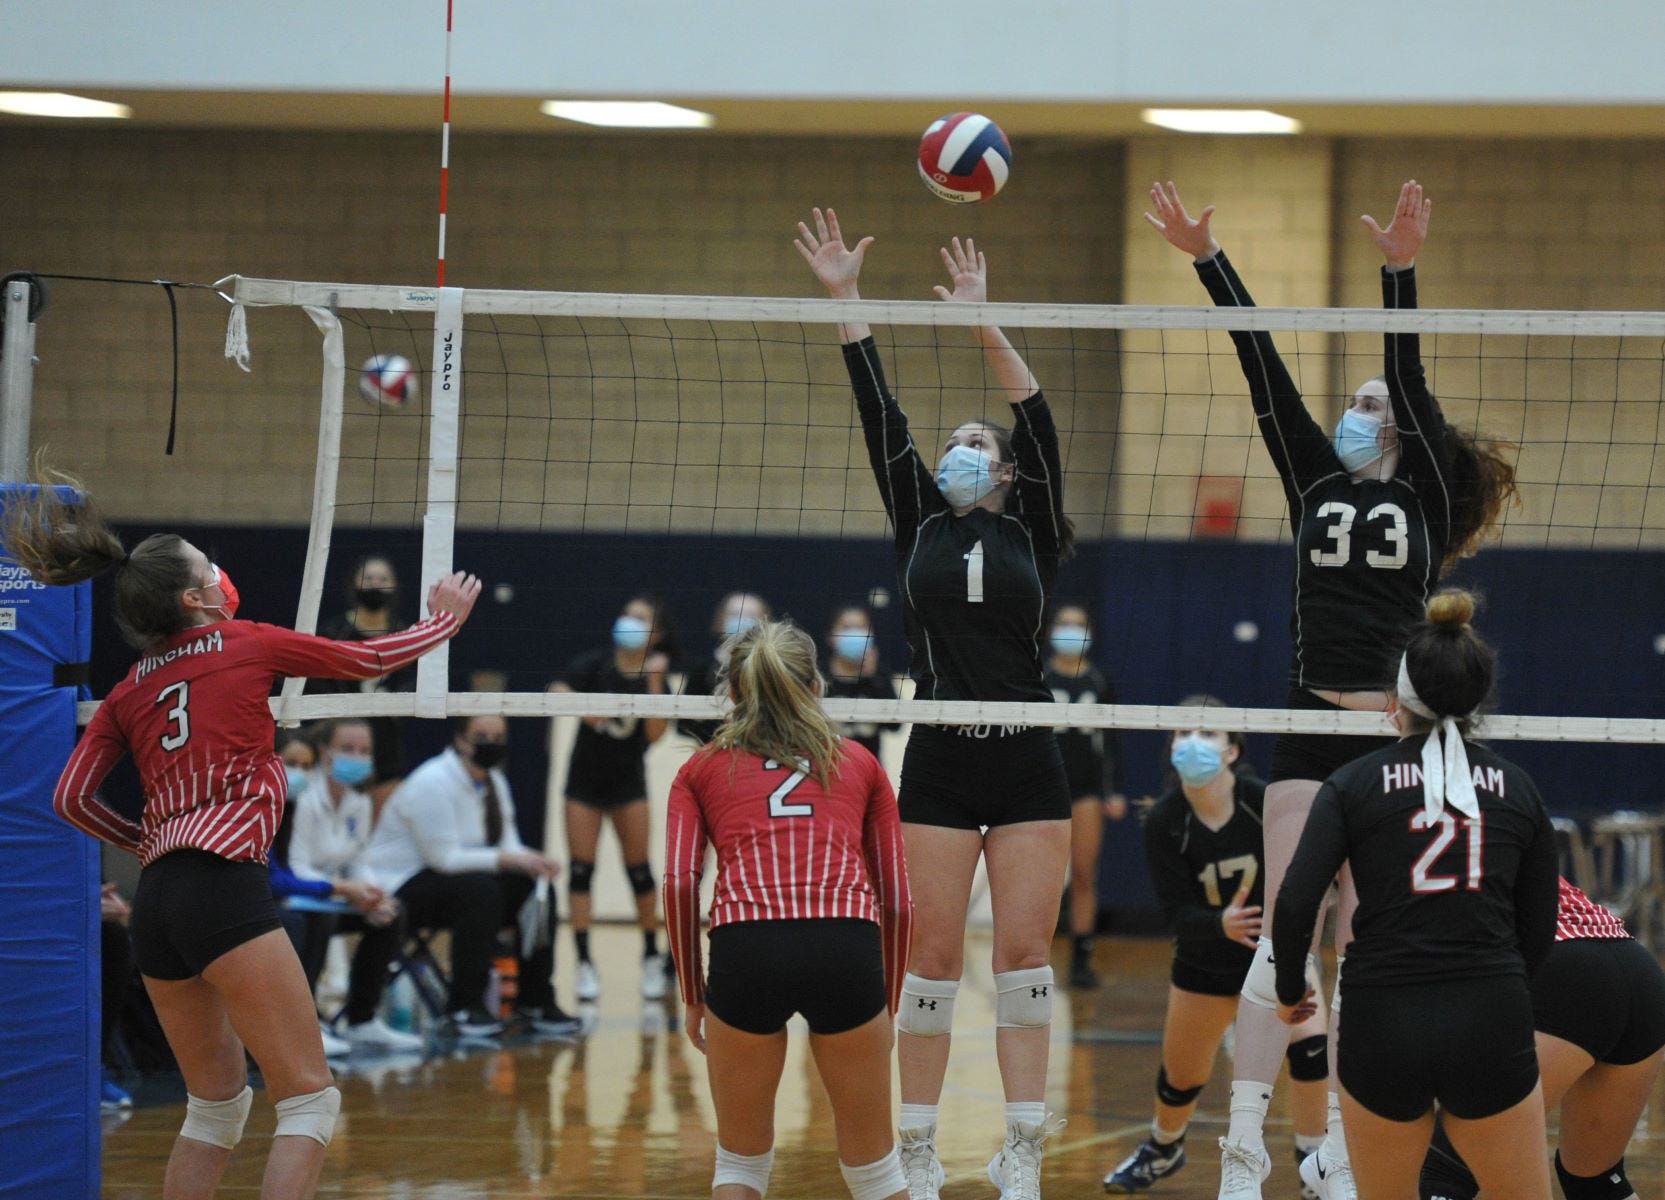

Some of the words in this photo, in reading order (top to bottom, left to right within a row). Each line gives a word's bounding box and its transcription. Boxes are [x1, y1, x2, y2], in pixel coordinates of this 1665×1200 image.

[442, 332, 453, 391] Jaypro
[1310, 501, 1409, 570] 33
[963, 539, 984, 602] 1
[156, 680, 190, 752] 3
[763, 755, 814, 818] 2
[1382, 762, 1505, 799] HINAM
[1198, 853, 1258, 907] 17
[1409, 807, 1485, 894] 21
